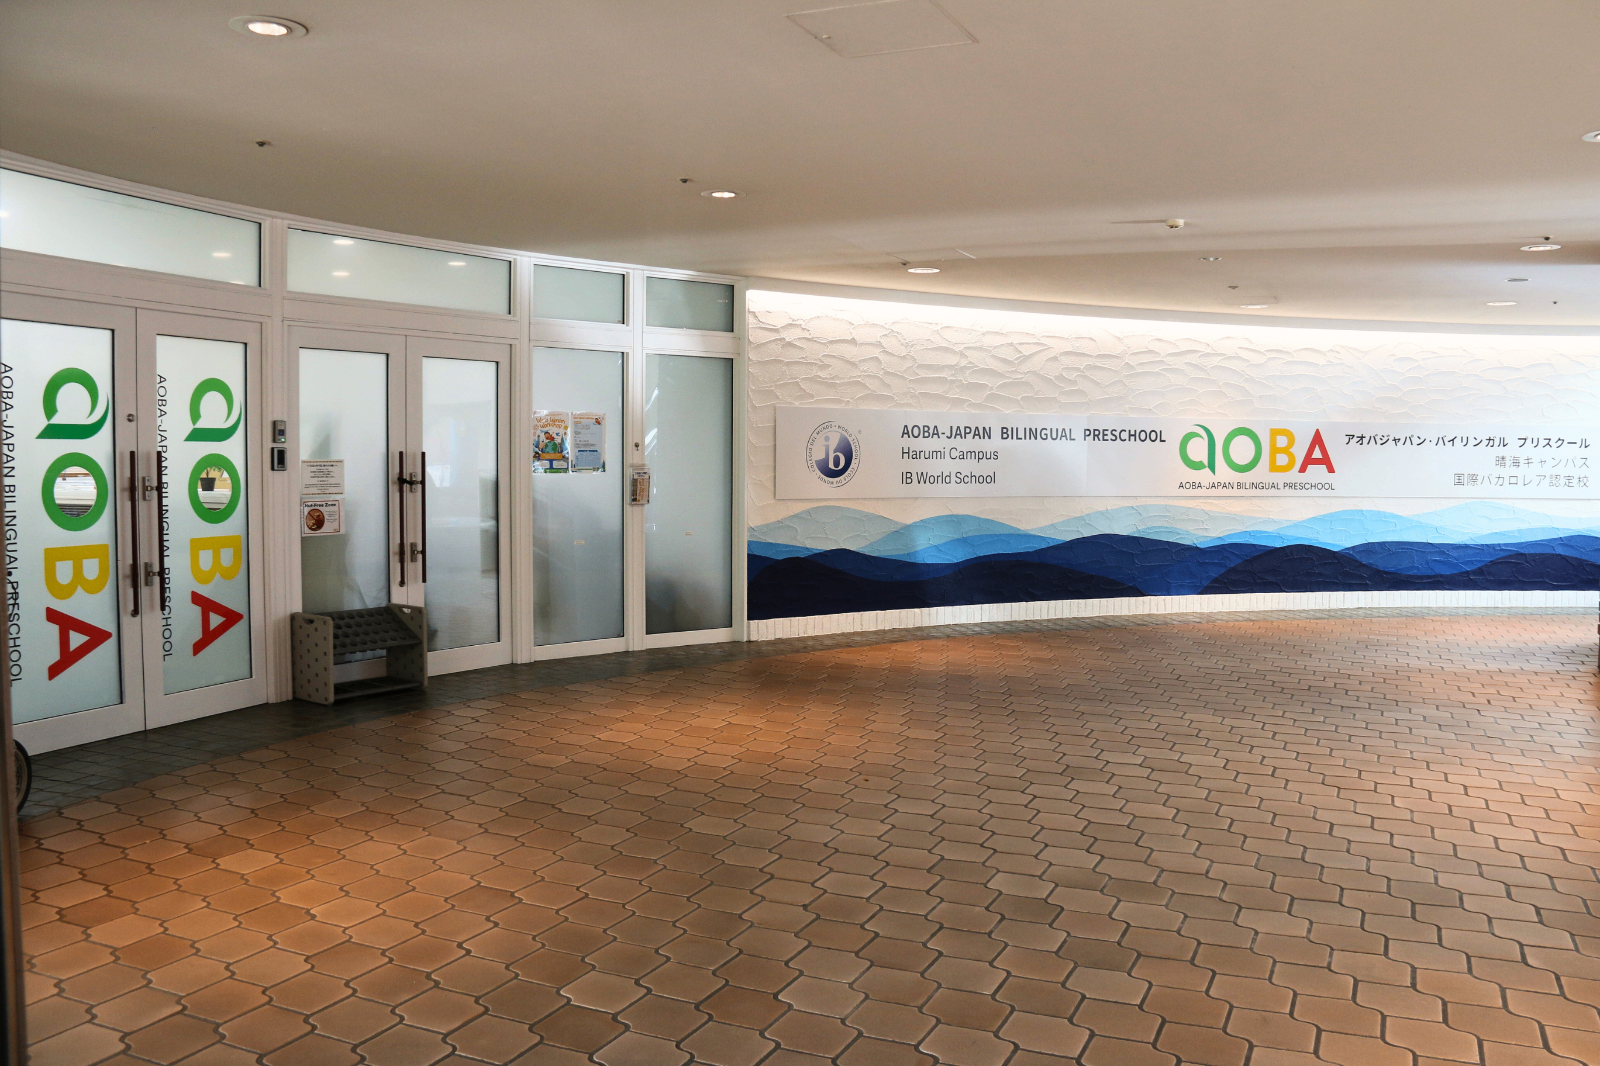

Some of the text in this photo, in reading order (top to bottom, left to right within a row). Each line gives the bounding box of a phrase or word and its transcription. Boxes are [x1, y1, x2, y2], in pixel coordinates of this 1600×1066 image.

[900, 424, 1167, 443] AOBA-JAPAN BILINGUAL PRESCHOOL
[1517, 436, 1591, 449] プリスクール
[901, 446, 999, 463] Harumi Campus
[1495, 455, 1590, 469] 晴海キャンパス
[901, 471, 996, 485] IB World School
[1453, 473, 1589, 488] 国際バカロレア認定校
[1178, 481, 1336, 491] AOBA-JAPAN BILINGUAL PRESCHOOL
